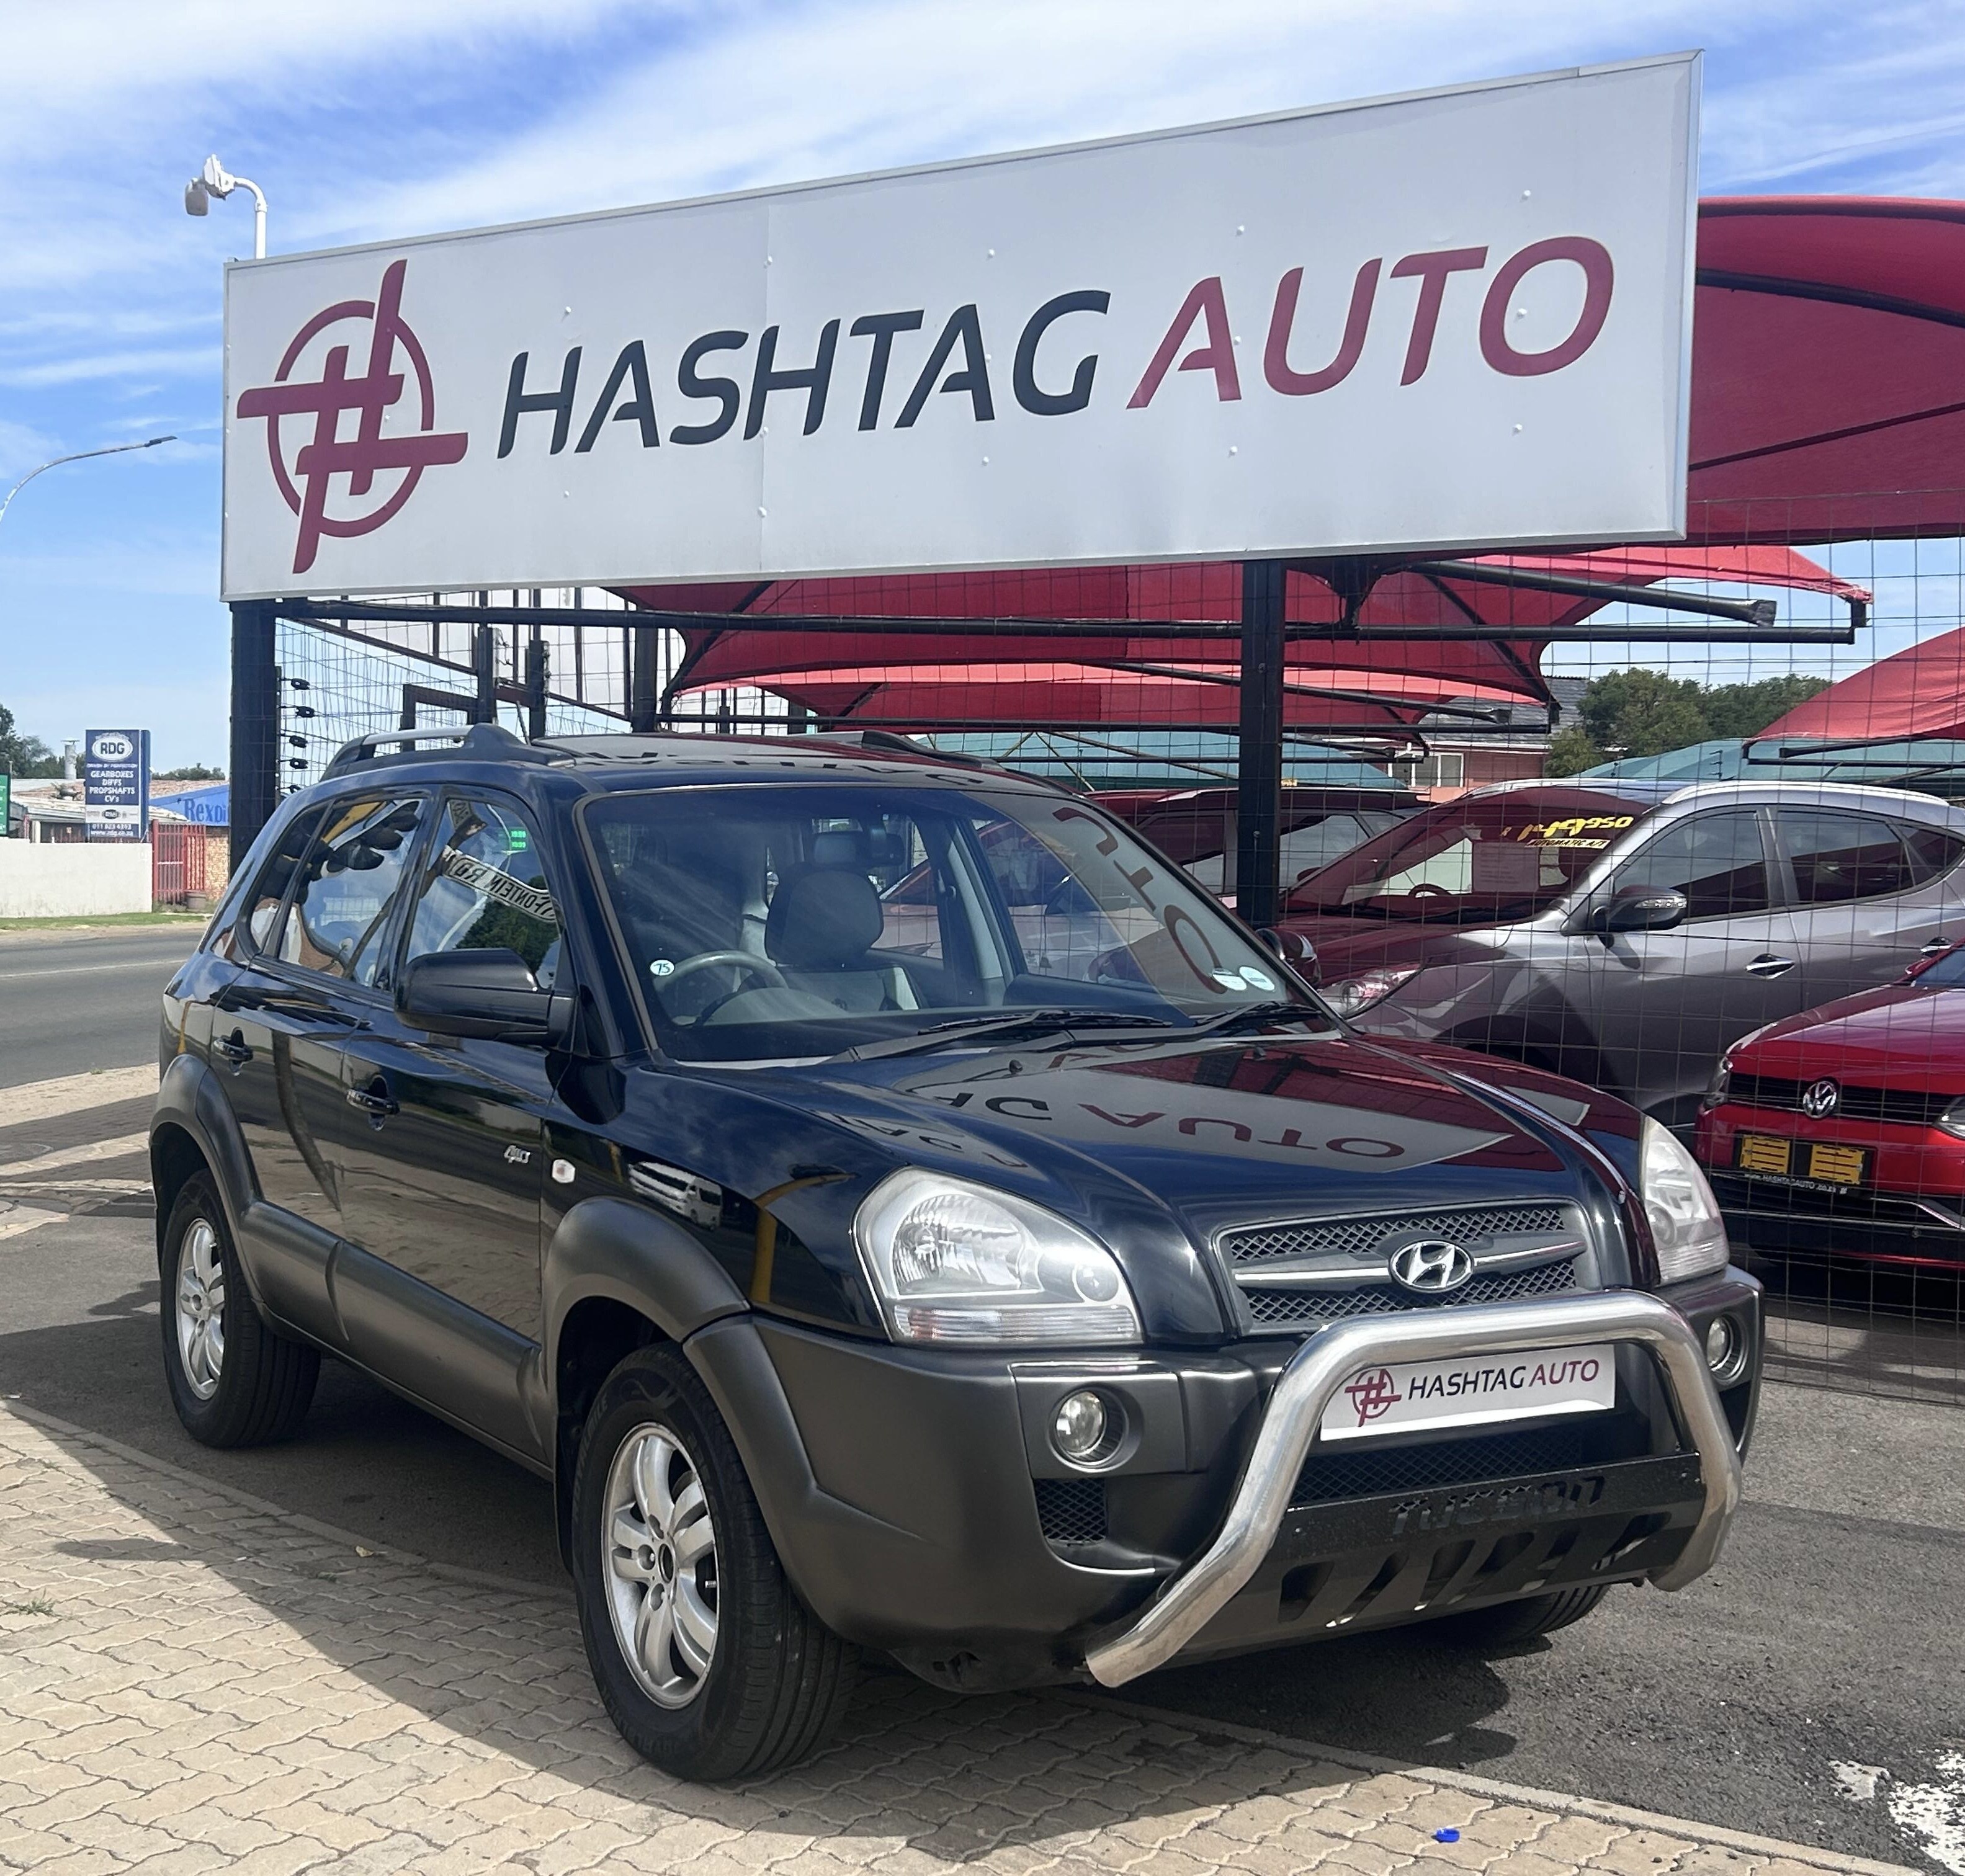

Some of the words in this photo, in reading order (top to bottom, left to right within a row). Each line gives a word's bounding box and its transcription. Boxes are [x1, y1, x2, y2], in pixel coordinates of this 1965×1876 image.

[498, 290, 1111, 458] HASHTAG
[1126, 236, 1614, 409] AUTO
[100, 742, 125, 754] RDG
[653, 962, 671, 974] 75
[1408, 1365, 1527, 1400] HASHTAG
[1529, 1359, 1600, 1387] AUTO
